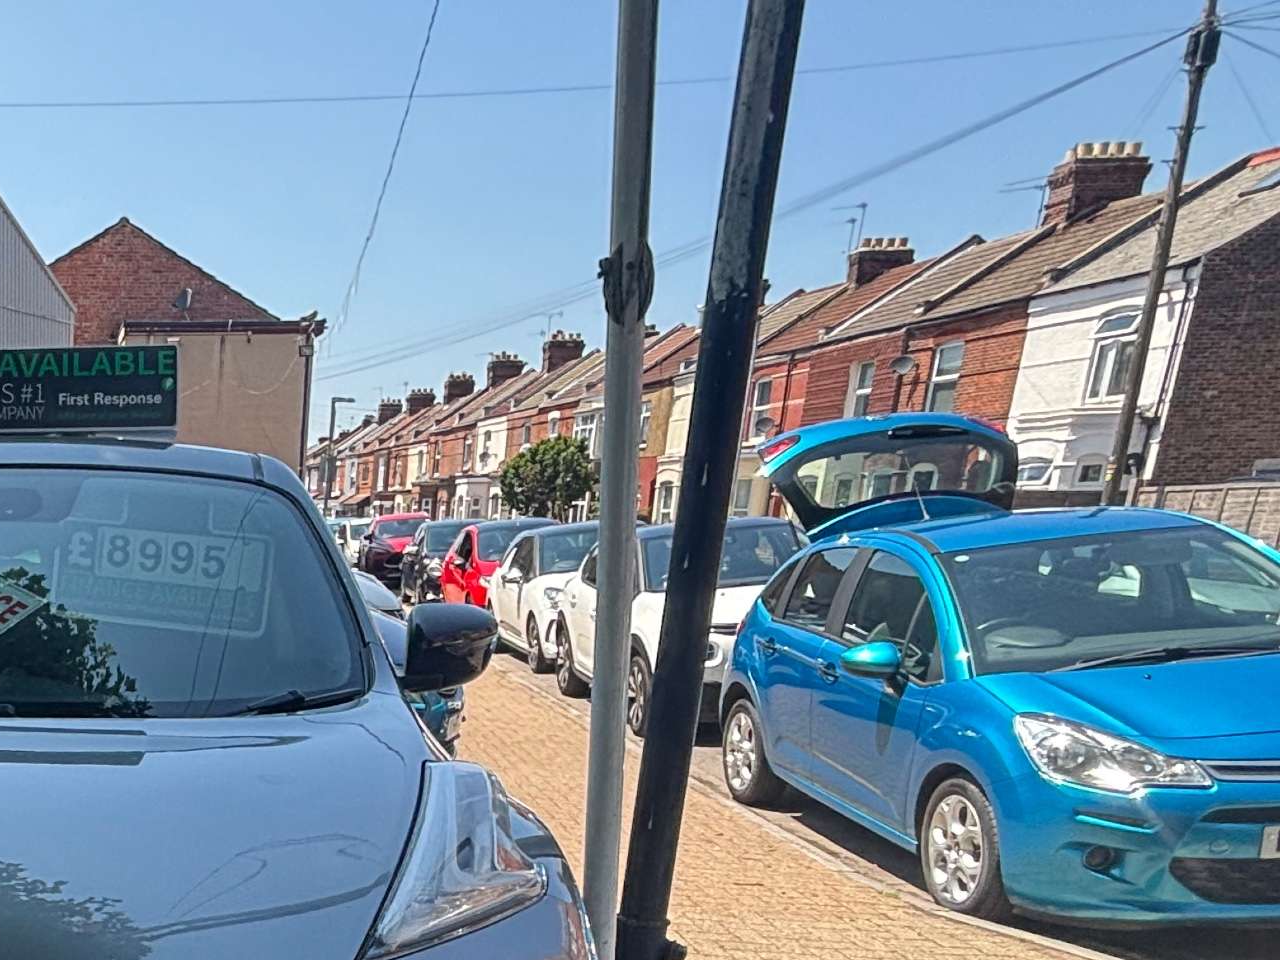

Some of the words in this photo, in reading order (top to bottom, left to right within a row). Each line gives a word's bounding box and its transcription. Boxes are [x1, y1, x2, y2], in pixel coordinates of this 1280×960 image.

[20, 382, 46, 404] #1
[59, 392, 89, 406] First
[94, 391, 163, 408] Response
